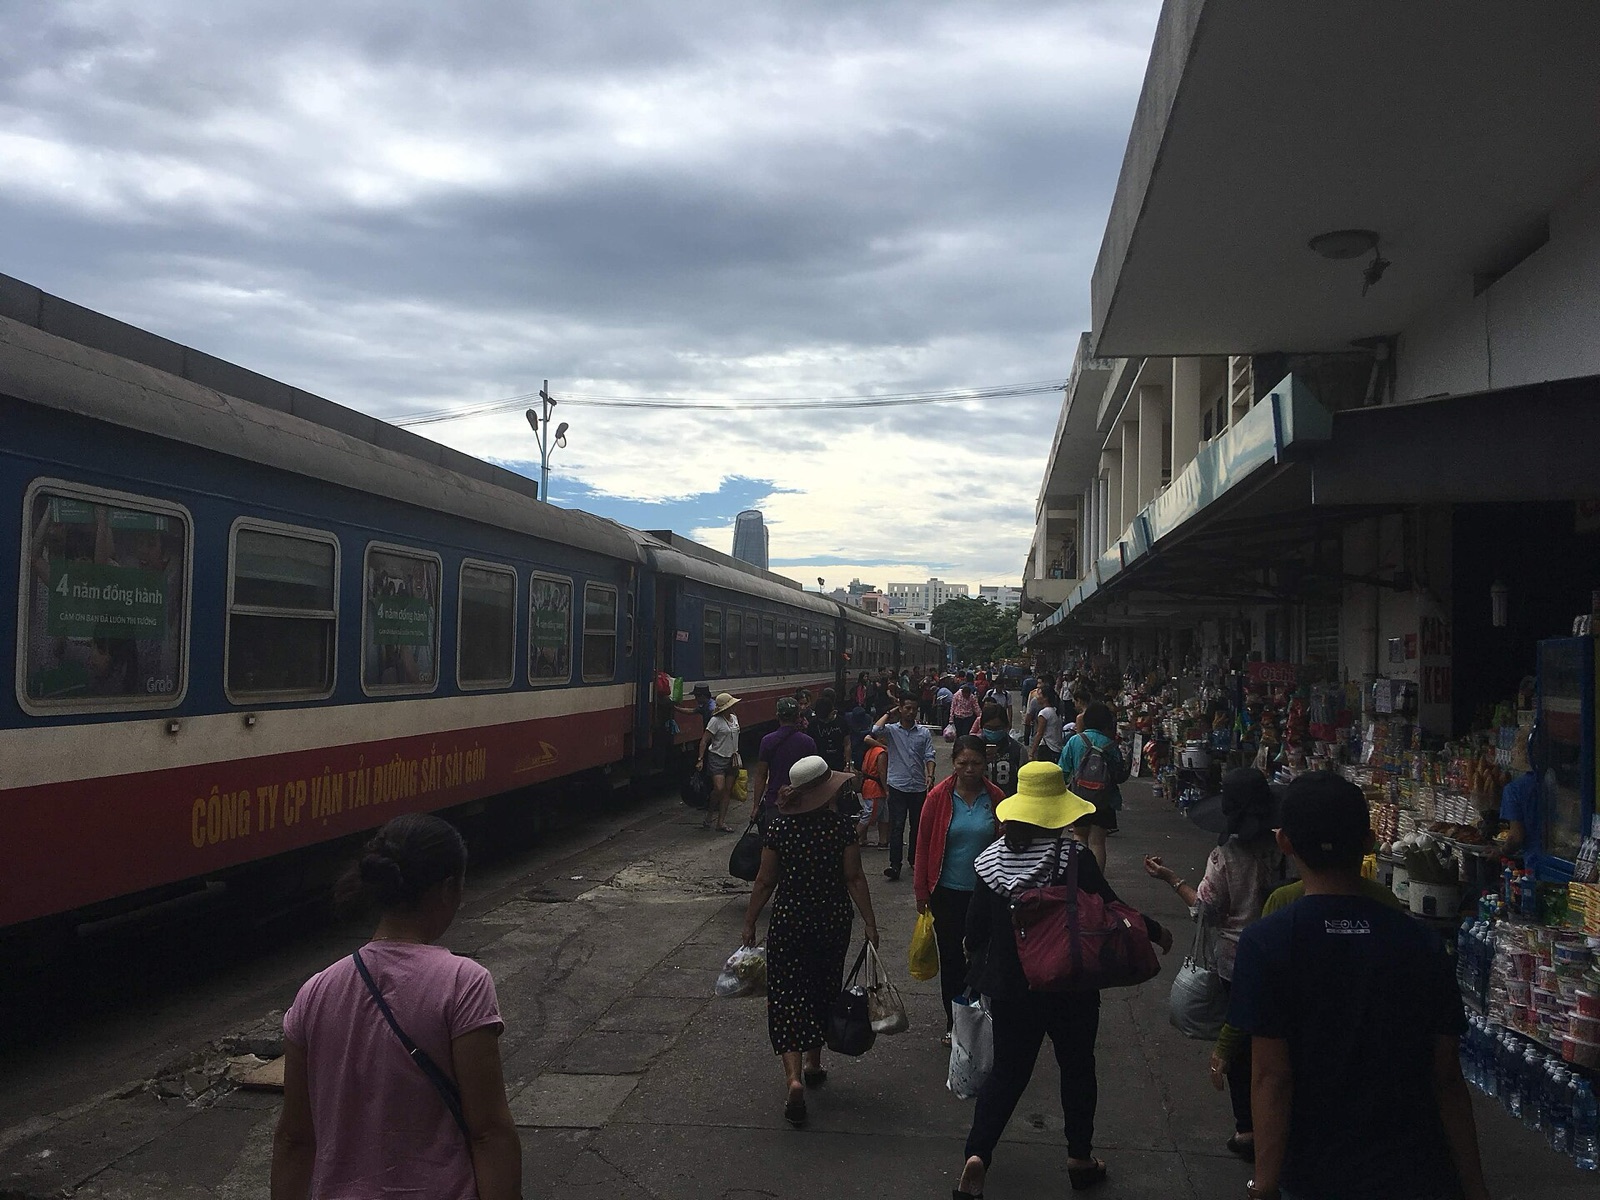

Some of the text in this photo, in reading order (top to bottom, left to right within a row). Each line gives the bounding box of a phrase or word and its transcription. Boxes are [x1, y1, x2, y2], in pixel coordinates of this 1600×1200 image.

[56, 573, 163, 606] 4 năm đồng hành
[377, 603, 384, 619] 4
[1259, 665, 1295, 682] Oishi
[146, 675, 174, 693] Grab
[191, 785, 250, 849] CÔNG
[256, 784, 280, 833] TY
[283, 779, 307, 827] CP
[311, 765, 343, 826] VẬN
[348, 754, 371, 810] TẢI
[373, 752, 418, 803] ĐƯỜNG
[420, 746, 443, 794] SẮT
[445, 744, 463, 788] SÀI
[464, 741, 487, 785] GÒN
[1324, 919, 1370, 929] NEOLAB
